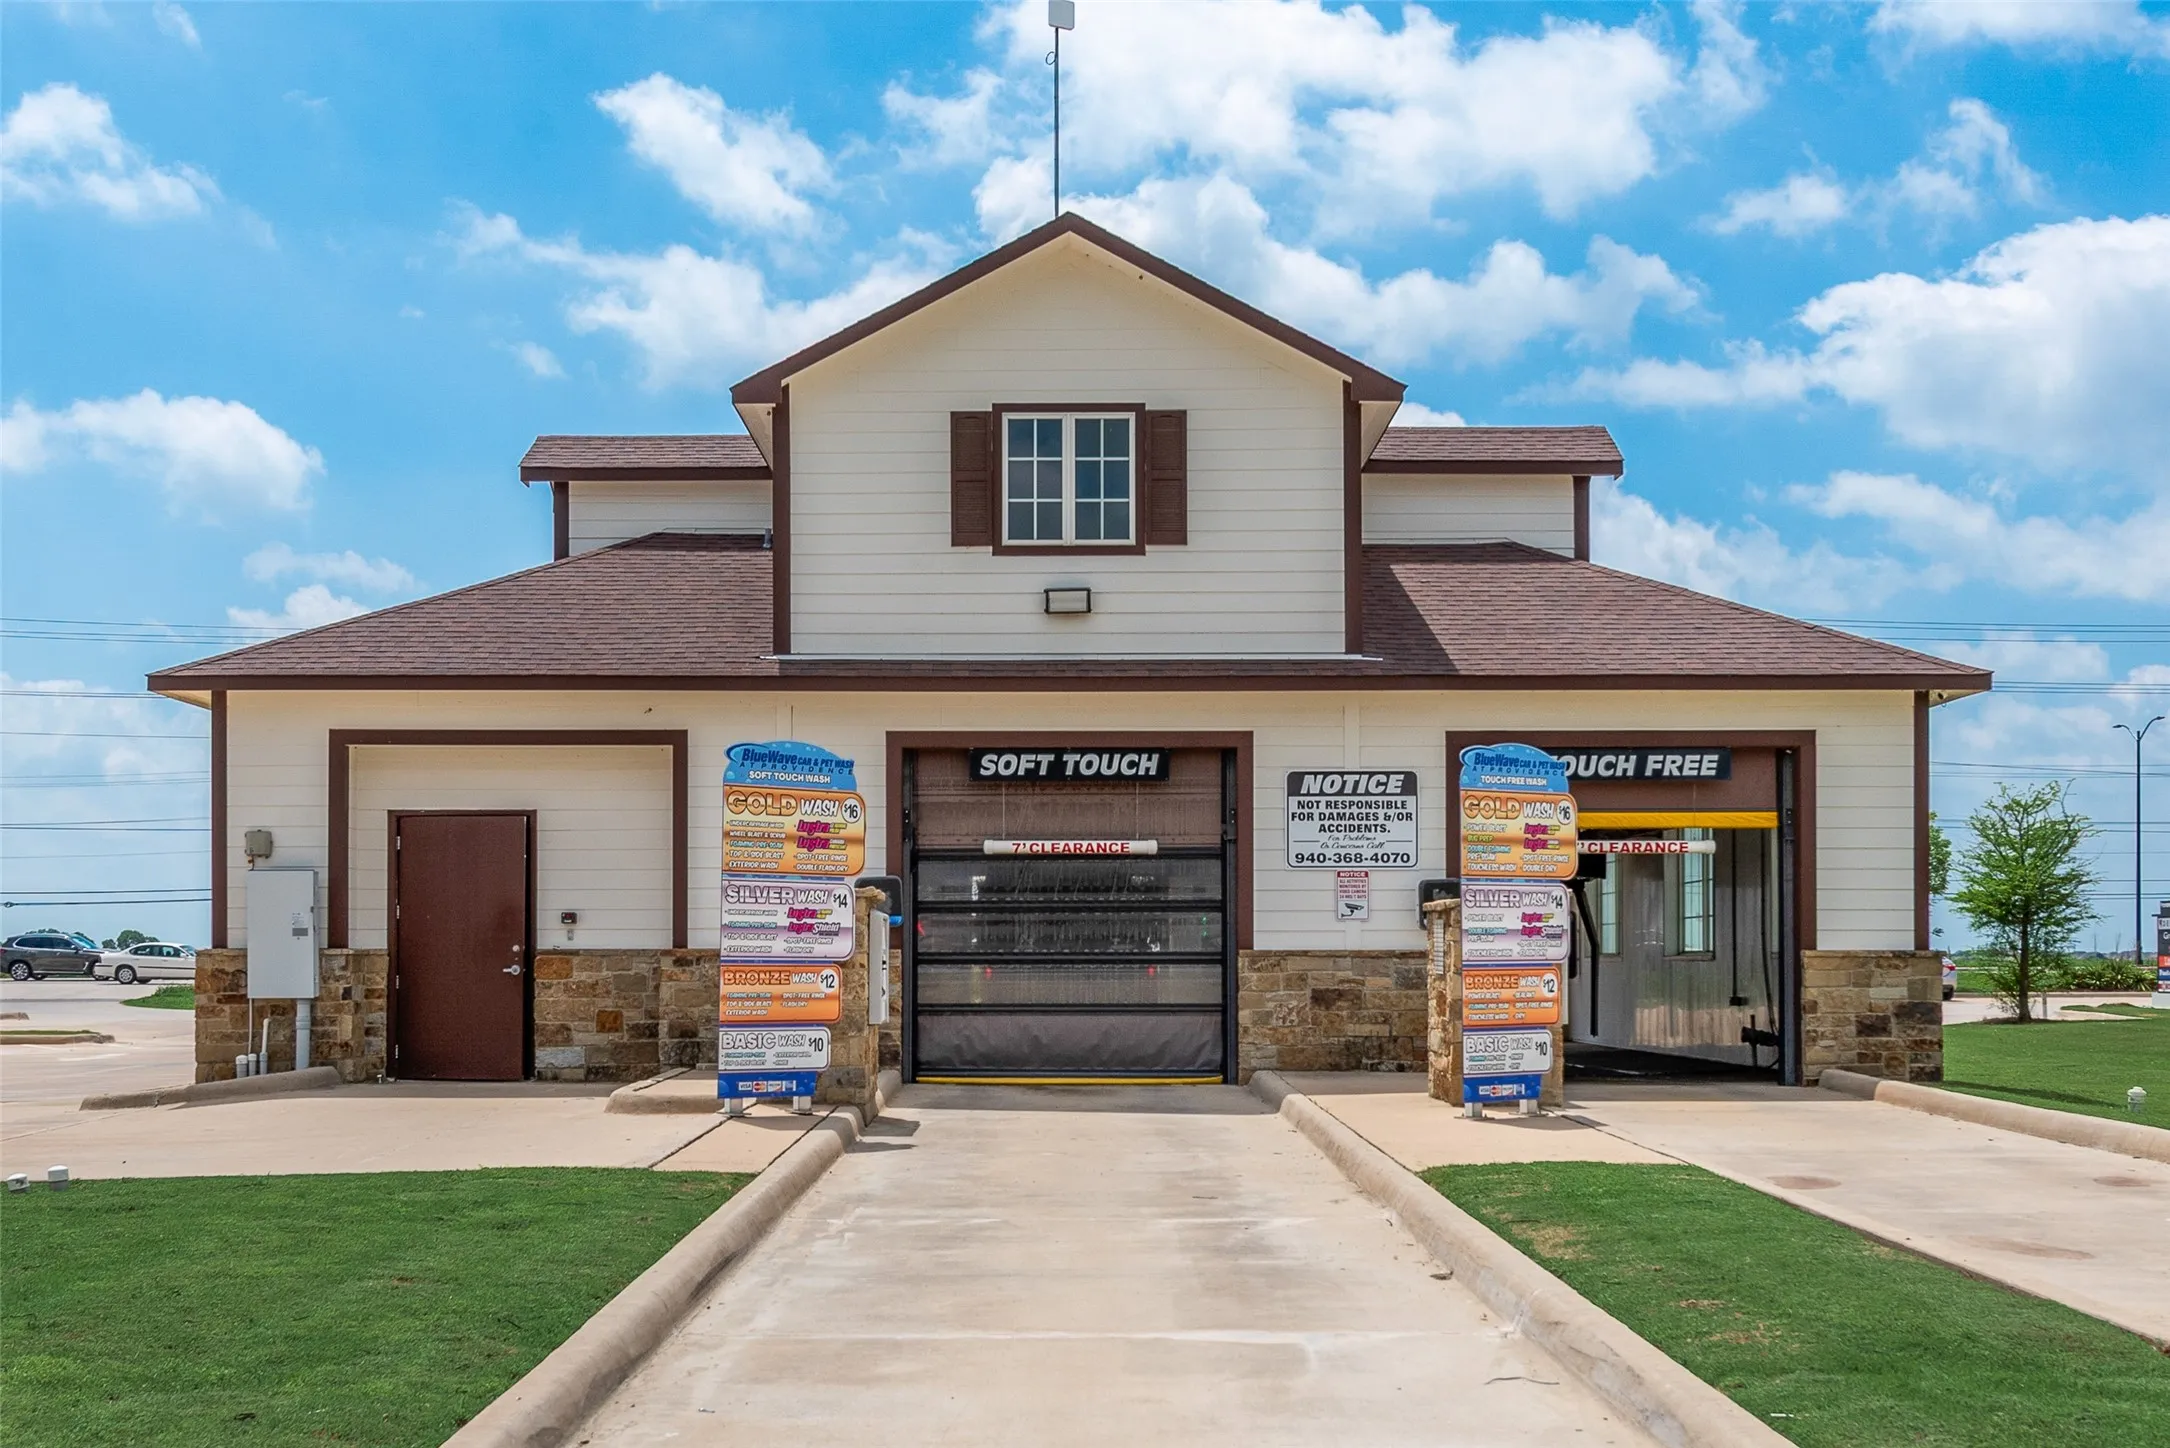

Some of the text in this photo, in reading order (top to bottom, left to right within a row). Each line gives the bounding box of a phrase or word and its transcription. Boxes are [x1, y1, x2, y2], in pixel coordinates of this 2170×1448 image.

[742, 748, 855, 770] BlueWave CAR & PET WASH
[980, 753, 1160, 776] SOFT TOUCH
[1474, 752, 1520, 768] BlueWave
[1520, 760, 1532, 768] CAR
[1538, 761, 1549, 770] PET
[1550, 761, 1566, 770] WASH
[1644, 754, 1720, 776] FREE
[749, 770, 831, 784] SOFT TOUCH WASH
[761, 762, 853, 776] PROVIDENCE
[1490, 766, 1564, 776] PROVIDENCE
[1300, 774, 1404, 794] NOTICE
[1480, 776, 1547, 786] TOUCH FREE WASH
[727, 790, 858, 819] GOLD WASH $16
[1297, 800, 1408, 810] NOT RESPONSIBLE
[1463, 795, 1572, 821] GOLD WASH $16
[1291, 812, 1413, 822] FOR DAMAGES &/OR
[1318, 824, 1391, 834] ACCIDENTS.
[764, 851, 785, 860] BLAST
[1030, 842, 1130, 854] CLEARANCE
[1588, 842, 1689, 854] CLEARANCE
[729, 860, 779, 870] EXTERIOR WASH
[1295, 852, 1410, 864] 940-368-4070
[726, 884, 848, 908] SILVER WASH $14
[1465, 889, 1520, 908] SILVER
[1522, 892, 1548, 907] WASH
[724, 970, 835, 988] BRONZE WASH $12
[1465, 974, 1556, 993] BRONZE WASH $12
[722, 1032, 824, 1052] BASIC WASH $10
[1466, 1036, 1548, 1056] BASIC WASH $10
